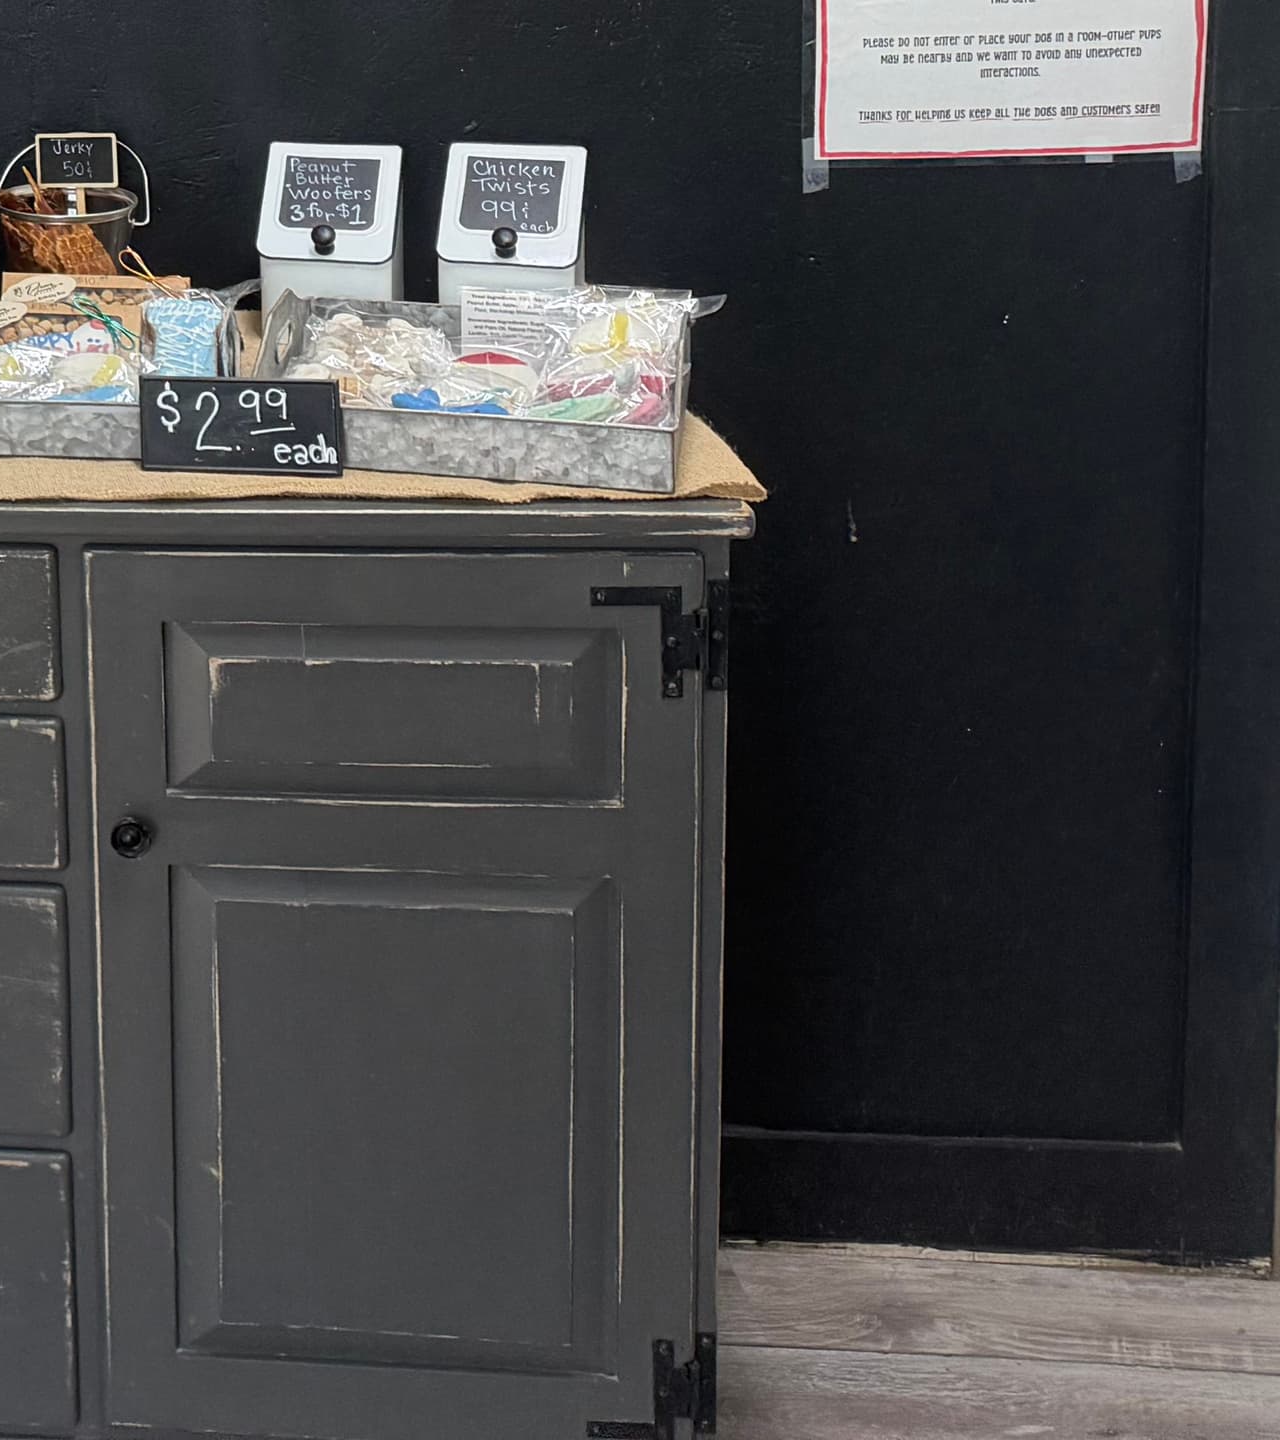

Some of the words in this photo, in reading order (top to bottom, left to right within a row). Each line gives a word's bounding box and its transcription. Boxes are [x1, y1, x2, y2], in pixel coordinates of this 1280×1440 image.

[51, 137, 95, 158] Jerky
[290, 158, 357, 174] Peanut
[473, 158, 556, 180] Chicken
[295, 172, 356, 187] Butter
[472, 177, 551, 196] Twists
[290, 203, 305, 222] 3
[306, 203, 336, 223] for
[336, 203, 367, 226] $1
[520, 221, 555, 233] each
[273, 433, 338, 466] each
